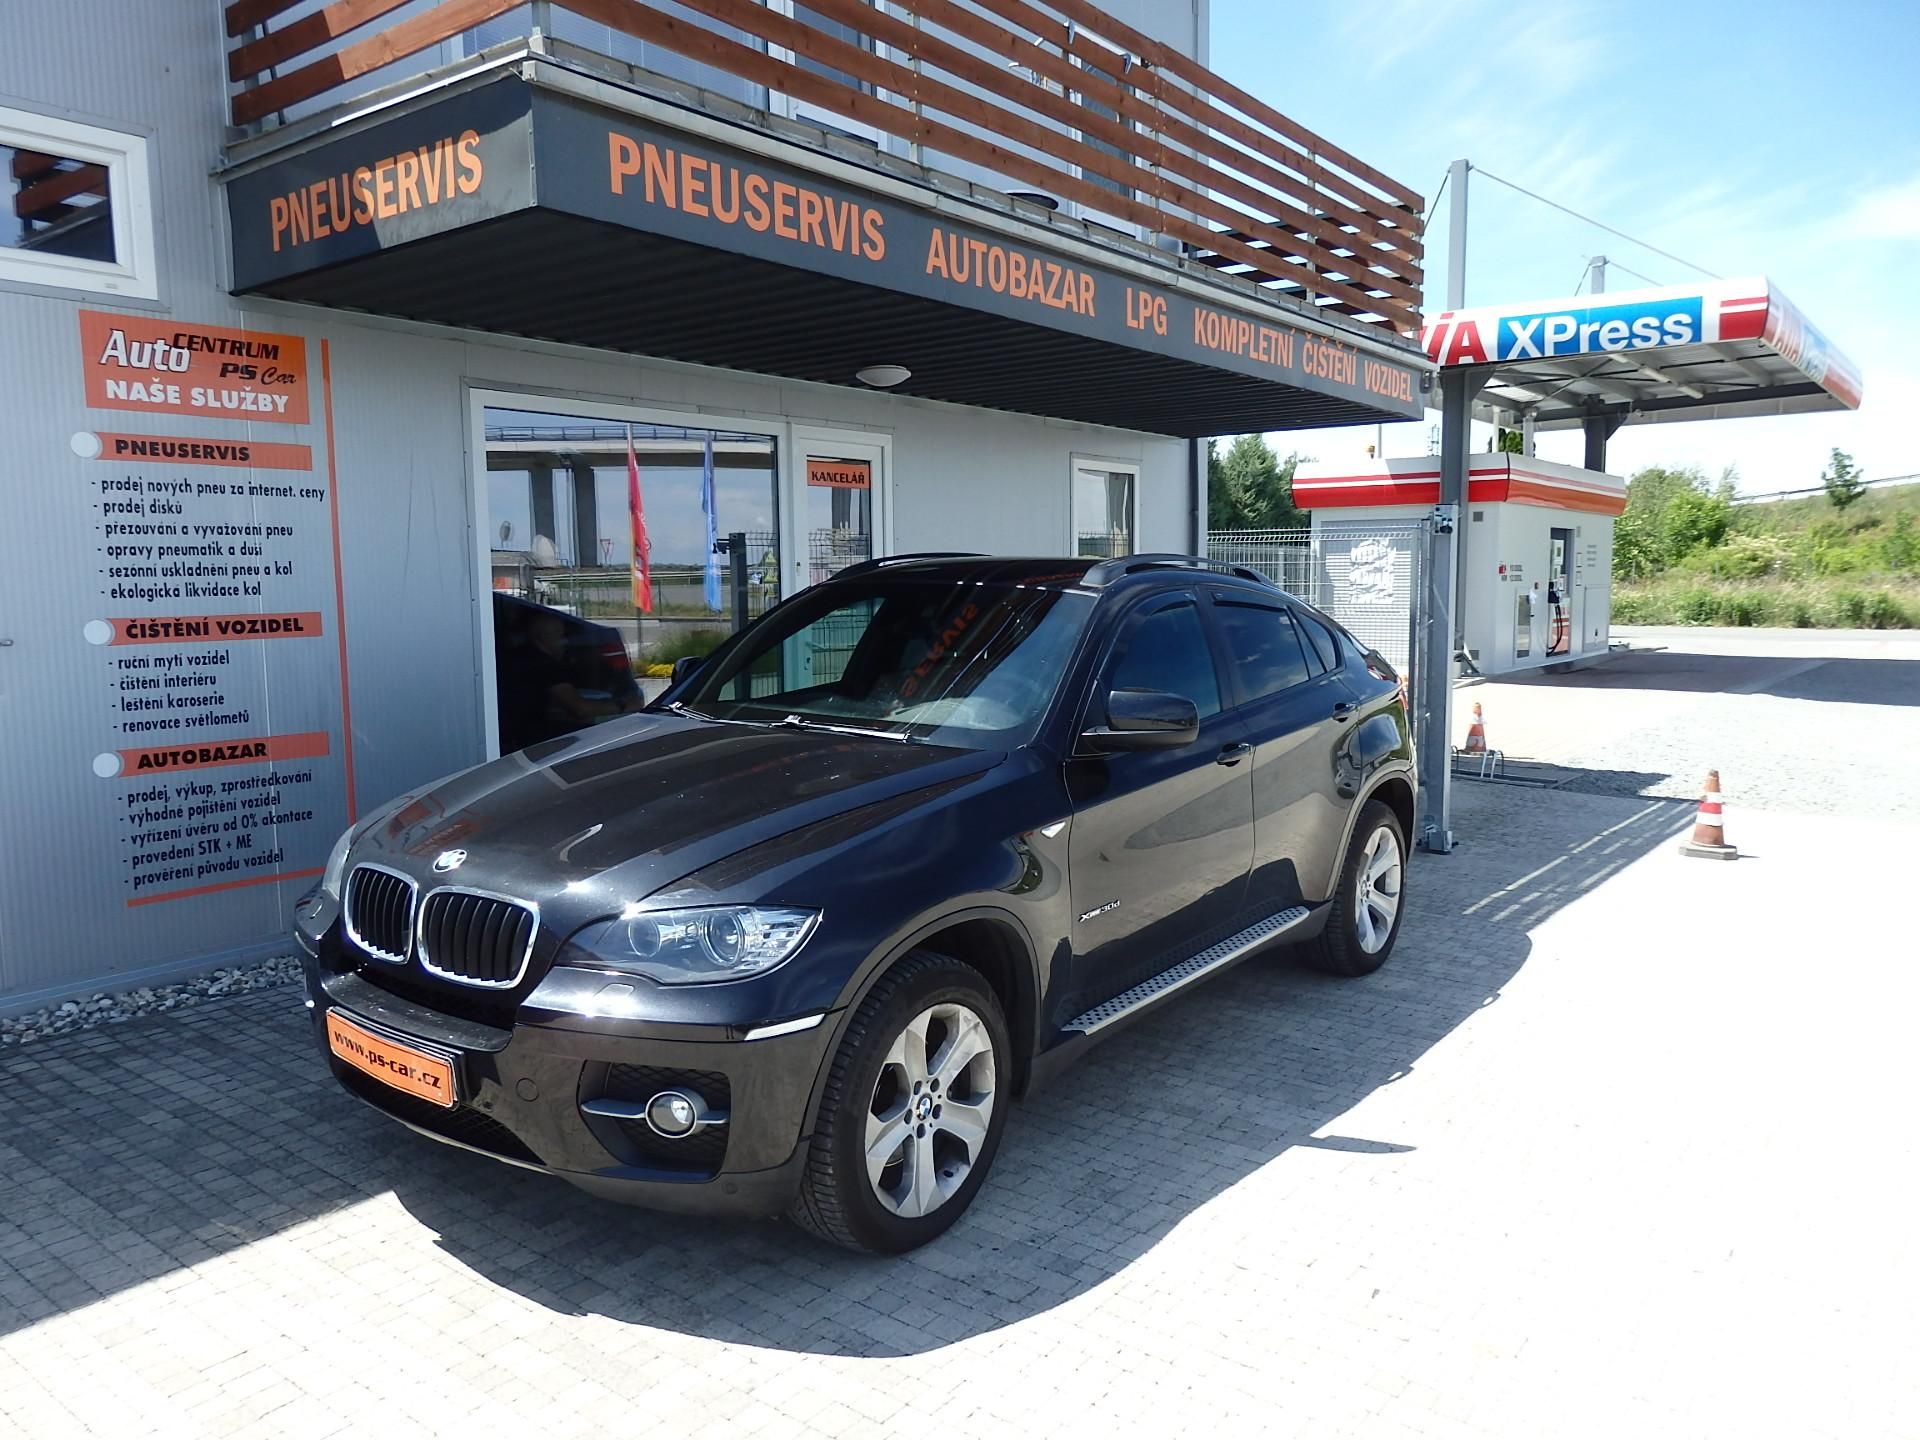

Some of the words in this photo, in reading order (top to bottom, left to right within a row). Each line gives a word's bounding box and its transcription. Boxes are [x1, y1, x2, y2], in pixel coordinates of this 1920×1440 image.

[270, 129, 484, 252] PNEUSERVIS
[608, 132, 885, 262] PNEUSERVIS
[926, 228, 1095, 317] AUTOBAZAR
[1126, 287, 1167, 336] LPG
[1194, 308, 1293, 370] KOMPLETNÍ
[1303, 331, 1357, 386] ČIŠTĚNÍ
[1364, 359, 1413, 403] VOZIDEL
[99, 328, 191, 373] Auto
[172, 333, 279, 361] CENTRUM
[1420, 312, 1488, 366] IA
[1507, 312, 1693, 361] XPress
[220, 362, 257, 380] PS
[261, 367, 296, 385] Car
[105, 376, 181, 405] NAŠE
[191, 386, 289, 413] SLUŽBY
[115, 439, 250, 462] PNEUSERVIS
[101, 476, 143, 496] prodej
[147, 478, 192, 496] nových
[197, 483, 226, 497] pneu
[230, 484, 244, 495] za
[248, 481, 296, 497] internet.
[300, 488, 325, 502] ceny
[811, 471, 865, 484] KANCELÁŘ
[103, 498, 145, 517] prodej
[105, 521, 177, 539] přezouvání
[181, 525, 189, 535] a
[193, 523, 262, 539] vyvažování
[266, 526, 293, 539] pneu
[107, 546, 153, 560] opravy
[158, 541, 224, 560] pneumatik
[229, 546, 235, 555] a
[109, 563, 157, 577] sezónní
[161, 561, 228, 577] uskladnění
[232, 565, 260, 579] pneu
[264, 566, 271, 576] a
[275, 561, 293, 575] kol
[111, 583, 180, 602] ekologická
[185, 582, 239, 598] likvidace
[243, 581, 262, 596] kol
[125, 616, 210, 639] ČIŠTĚNÍ
[216, 617, 304, 634] VOZIDEL
[118, 655, 150, 669] ruční
[187, 650, 230, 666] vozidel
[120, 675, 160, 691] čištění
[164, 672, 216, 688] interiéru
[121, 696, 164, 711] leštění
[167, 691, 225, 708] karoserie
[123, 718, 181, 733] renovace
[137, 743, 267, 770] AUTOBAZAR
[176, 782, 216, 800] výkup,
[221, 769, 312, 795] zprostředkování
[129, 805, 183, 827] výhodné
[188, 797, 237, 820] pojištění
[240, 791, 281, 809] vozidel
[131, 825, 182, 848] vyřízení
[186, 823, 219, 837] úvěru
[223, 816, 237, 831] od
[241, 813, 258, 829] 0%
[262, 810, 313, 826] akontace
[132, 843, 194, 869] provedení
[198, 838, 222, 856] STK
[236, 833, 252, 850] ME
[134, 864, 194, 890] prověření
[244, 848, 284, 867] vozidel
[334, 1031, 442, 1090] www.ps-car.cz
